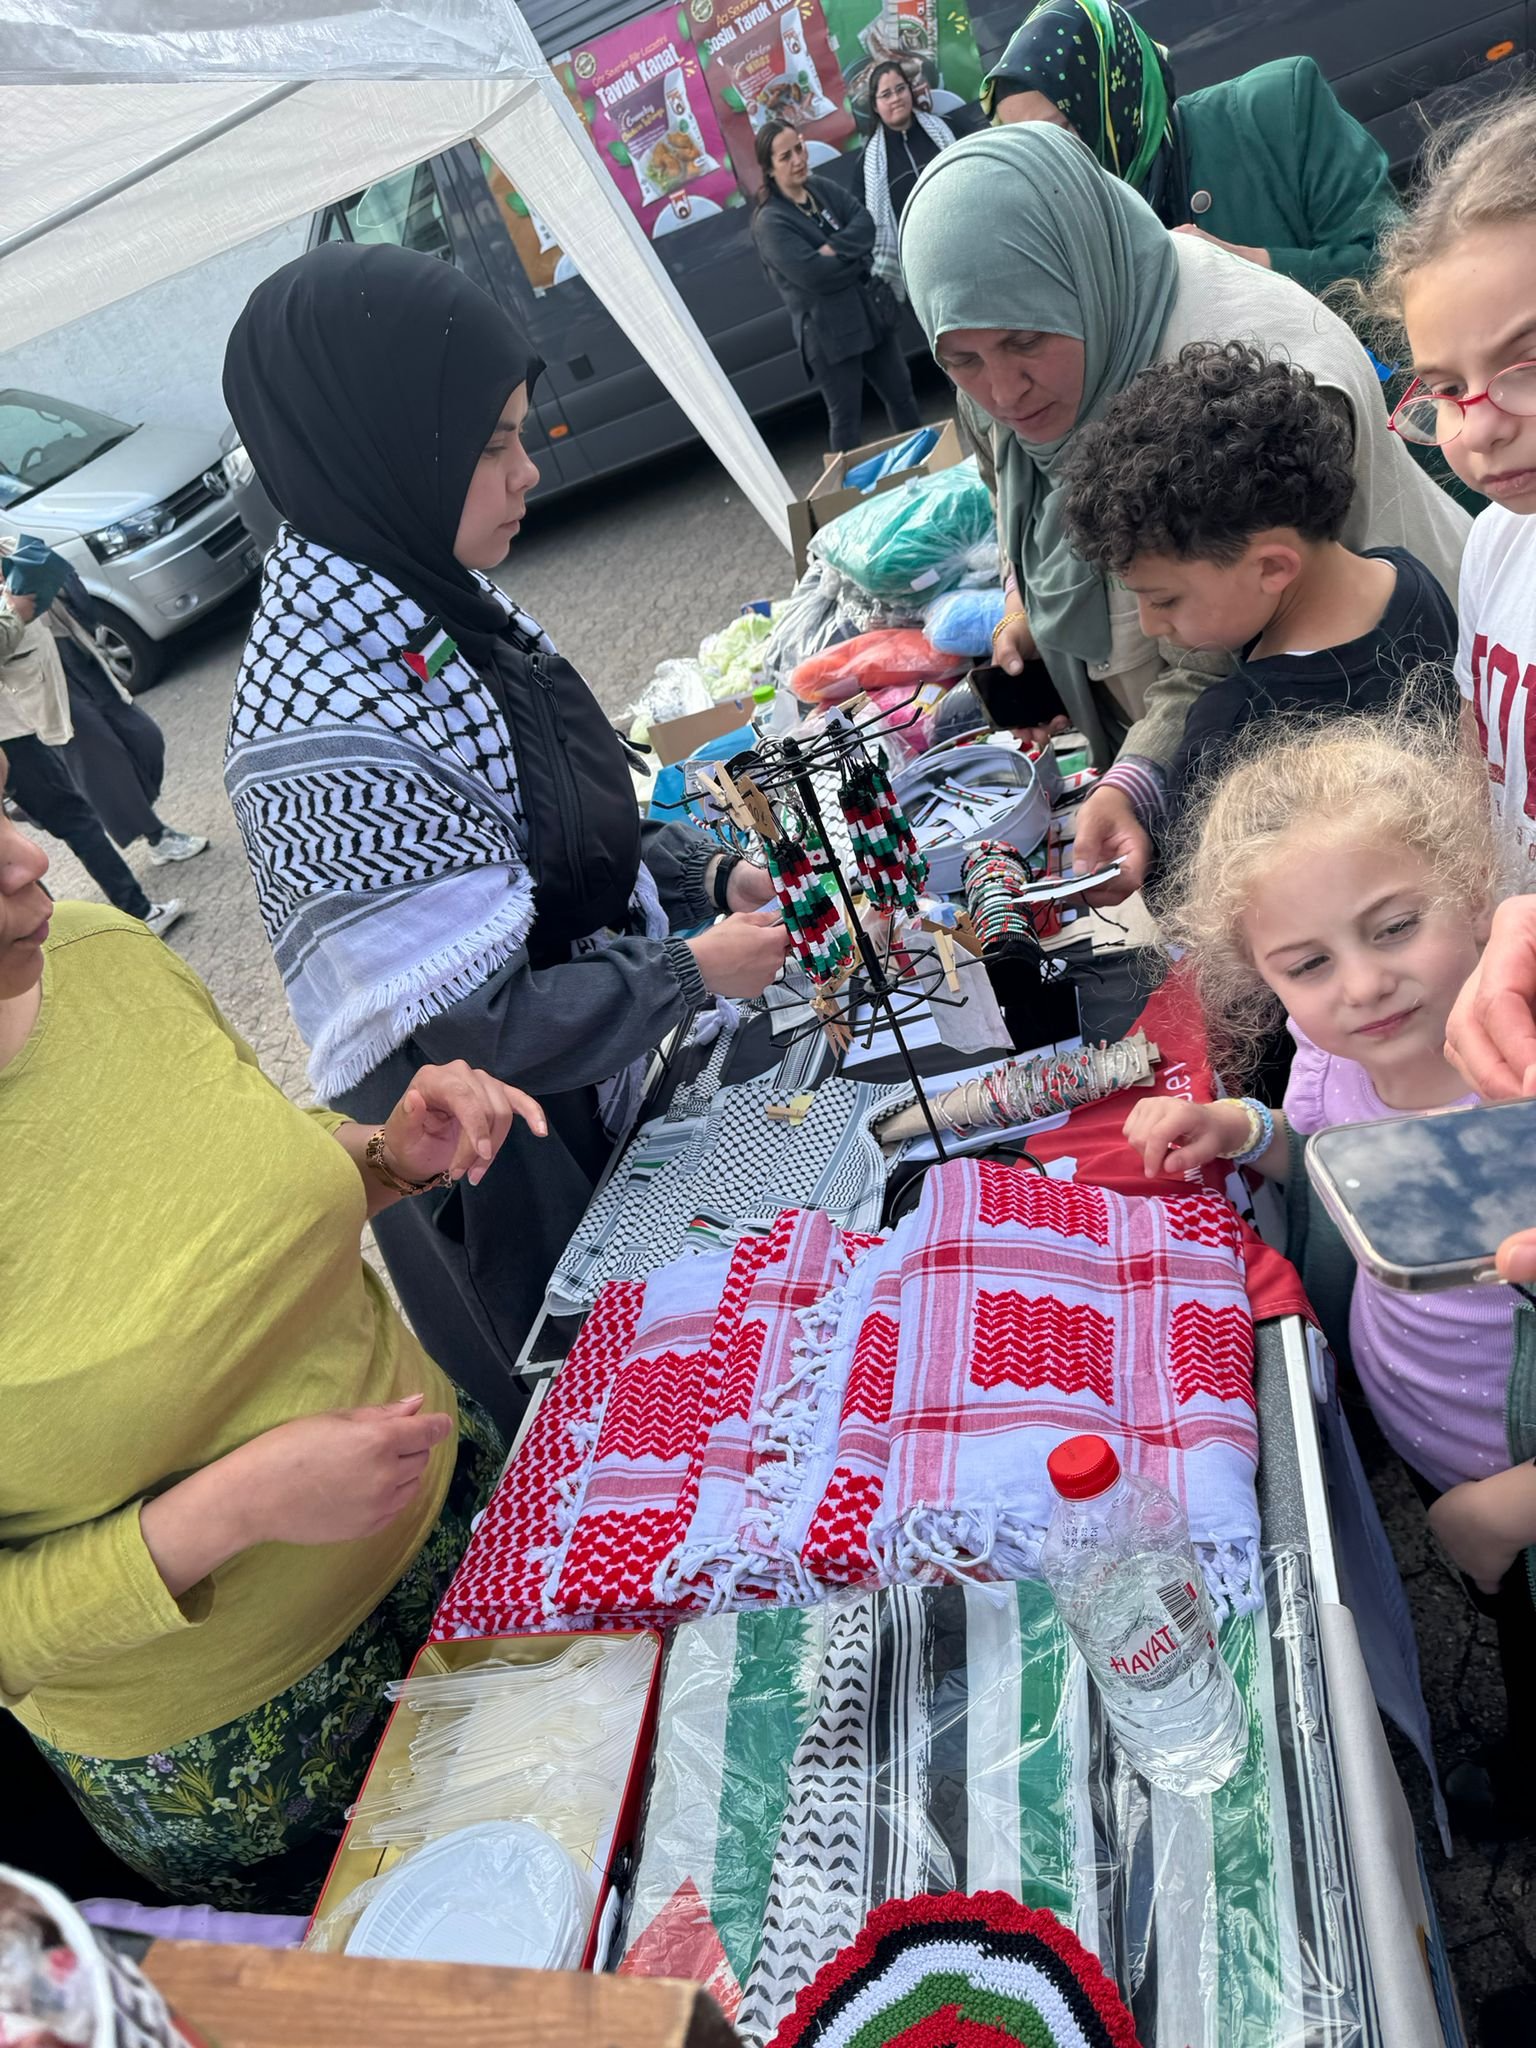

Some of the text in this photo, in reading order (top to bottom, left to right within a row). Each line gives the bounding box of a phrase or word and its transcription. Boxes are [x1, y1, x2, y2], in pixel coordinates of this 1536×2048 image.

[703, 25, 737, 55] Soslu
[734, 2, 771, 34] Tavuk
[595, 70, 640, 108] Tavuk
[636, 42, 680, 83] Kanat
[1110, 1624, 1177, 1675] HAYAT
